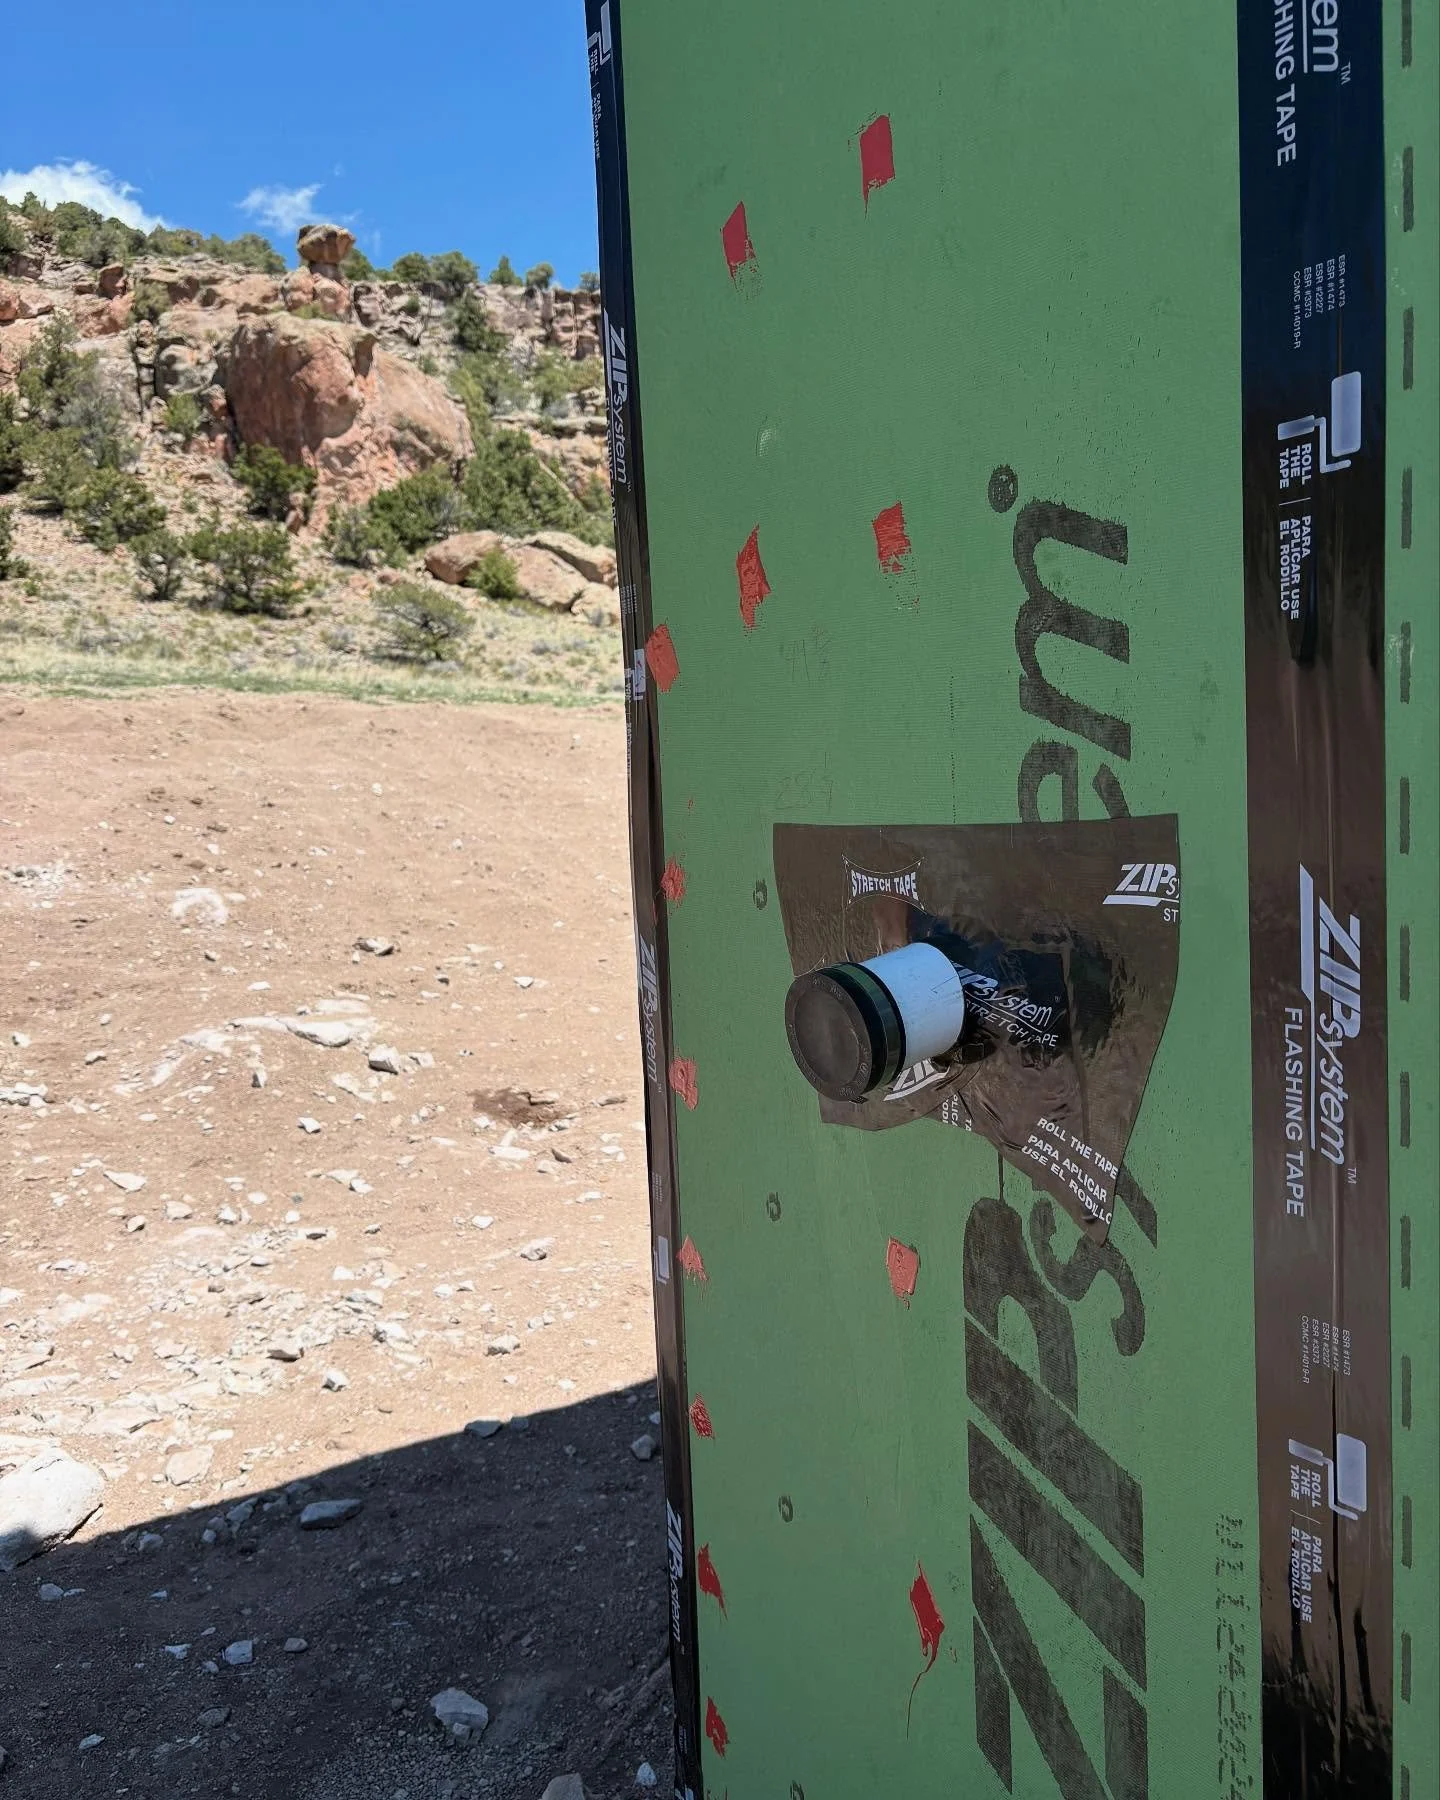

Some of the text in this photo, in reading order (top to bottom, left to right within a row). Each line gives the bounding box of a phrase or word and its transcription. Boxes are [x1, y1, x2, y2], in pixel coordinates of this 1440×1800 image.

[1276, 83, 1297, 166] TAPE
[1293, 271, 1301, 302] CCMC
[1315, 262, 1323, 284] ESR
[1327, 259, 1335, 280] ESR
[1338, 254, 1346, 307] ESR #1473
[1304, 266, 1312, 318] ESR #3373
[610, 323, 628, 484] ZIPsystem
[1279, 448, 1290, 489] TAPE
[1290, 445, 1301, 478] THE
[1301, 443, 1312, 485] ROLL
[1301, 515, 1312, 558] PARA
[1279, 520, 1290, 611] EL RODILLO
[1290, 518, 1301, 620] APLICAR USE
[851, 869, 919, 901] STRETCH TAPE
[640, 933, 659, 1083] ZIPsystem
[1319, 896, 1362, 1165] ZIPsystem
[1284, 1007, 1305, 1217] FLASHING TAPE
[1021, 1146, 1049, 1166] USE
[1050, 1162, 1066, 1181] EL
[1027, 1135, 1107, 1202] PARA APLICAR
[1037, 1118, 1119, 1180] ROLL THE TAPE
[1301, 1315, 1309, 1342] CCMC
[1322, 1322, 1330, 1340] ESR
[1342, 1329, 1351, 1348] ESR
[1290, 1464, 1300, 1500] TAPE
[1300, 1468, 1311, 1497] THE
[1311, 1471, 1321, 1508] ROLL
[666, 1497, 684, 1643] ZIPsystem
[1291, 1526, 1301, 1609] EL RODILLO
[1312, 1535, 1322, 1573] PARA
[1301, 1530, 1312, 1623] APLICAR USE
